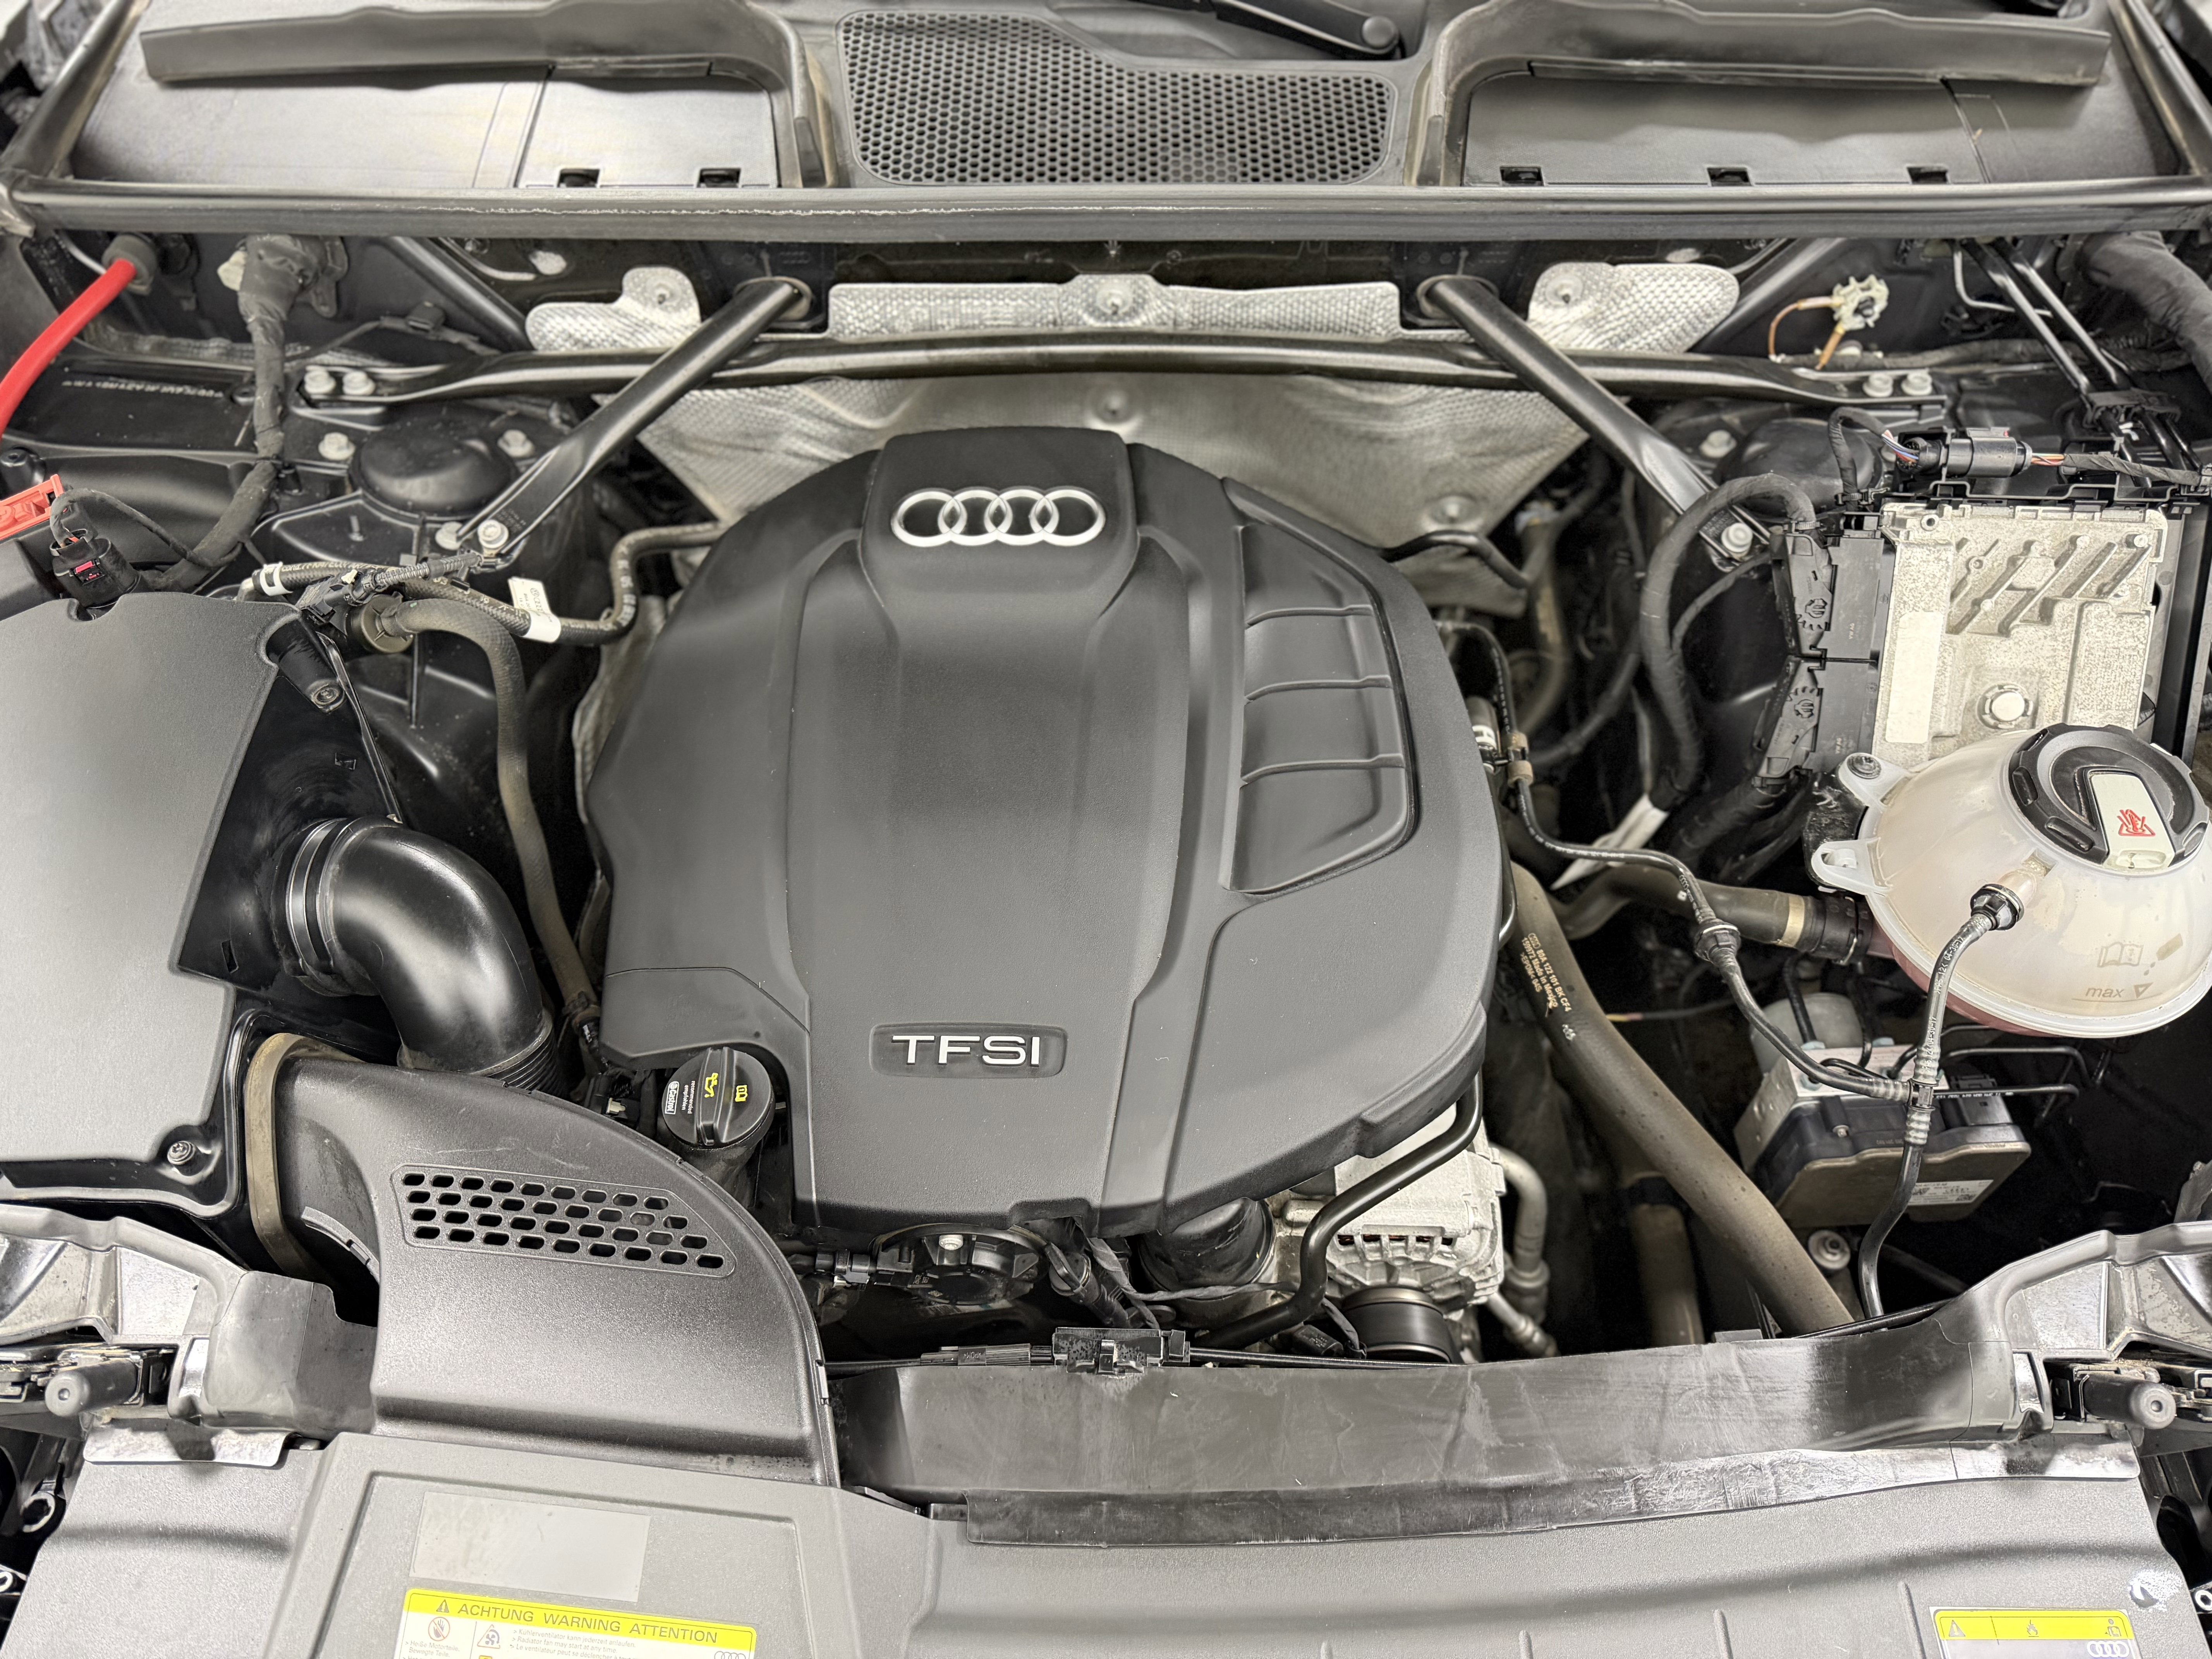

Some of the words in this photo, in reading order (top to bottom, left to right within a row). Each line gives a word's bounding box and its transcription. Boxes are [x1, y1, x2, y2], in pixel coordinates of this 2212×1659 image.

[1536, 949, 1547, 963] 80A
[1544, 963, 1554, 975] 122
[1532, 958, 1544, 976] Made
[1540, 975, 1547, 984] in
[1544, 984, 1559, 1008] Mexico
[1549, 975, 1560, 986] 101
[1554, 986, 1565, 998] BK
[2085, 987, 2124, 998] max
[1560, 998, 1572, 1012] CF4
[892, 1035, 1040, 1066] TFSI
[667, 1089, 677, 1112] Castrol
[687, 1080, 696, 1114] recommended
[458, 1603, 534, 1622] ACHTUNG
[544, 1613, 620, 1632] WARNING
[629, 1623, 717, 1643] ATTENTION
[517, 1637, 542, 1645] Radiator
[519, 1629, 565, 1640] Kühlerventilator
[582, 1637, 608, 1645] jederzeit
[609, 1640, 636, 1648] anlaufen.
[525, 1645, 555, 1654] ventilateur
